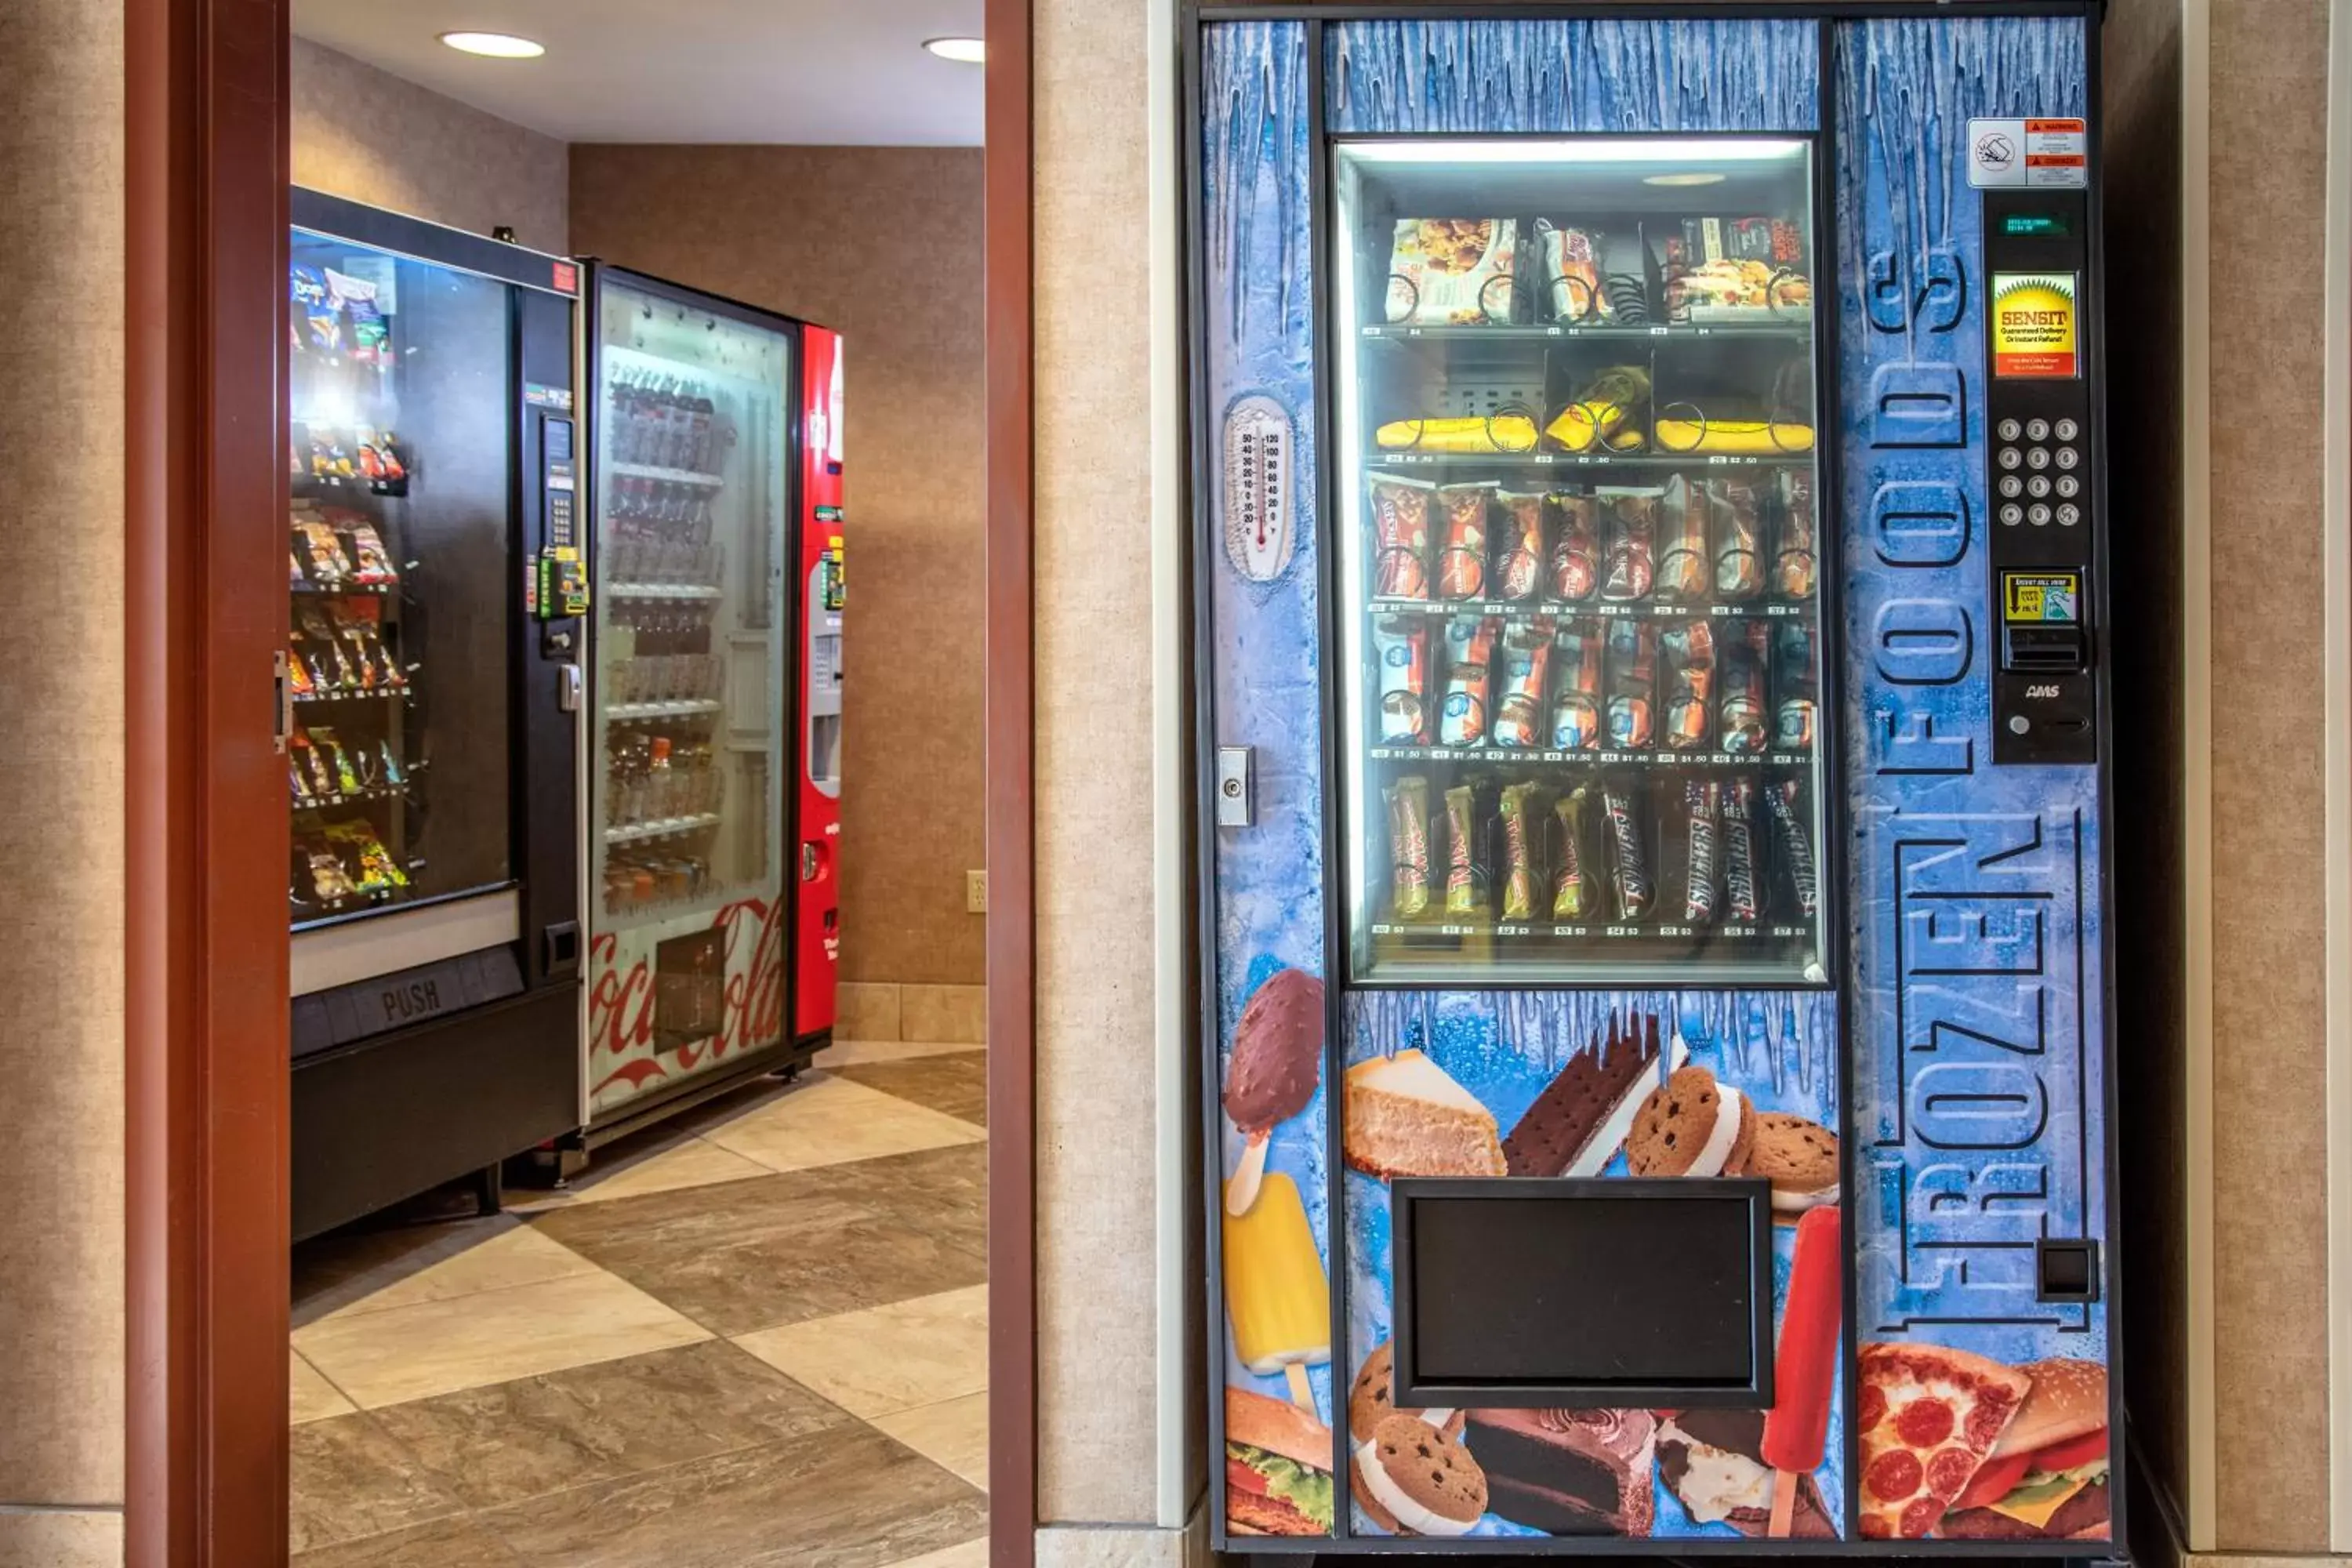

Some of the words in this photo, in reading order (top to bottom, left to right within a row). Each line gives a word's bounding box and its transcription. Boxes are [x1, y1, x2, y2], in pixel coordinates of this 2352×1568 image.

[2002, 311, 2065, 325] SENSIT
[1243, 434, 1252, 442] 50
[1266, 434, 1279, 443] 120
[1243, 445, 1252, 454] 40
[1243, 457, 1252, 466] 30
[1268, 460, 1277, 469] 80
[1243, 469, 1253, 477] 20
[1268, 473, 1277, 481] 60
[1244, 480, 1253, 488] 10
[1268, 485, 1278, 494] 40
[1245, 503, 1253, 511] 10
[1269, 498, 1278, 507] 20
[1867, 249, 1973, 776] FOODS
[1244, 514, 1254, 523] 20
[2025, 684, 2060, 698] AMS
[381, 978, 442, 1022] PUSH
[1867, 804, 2089, 1333] FROZEN
